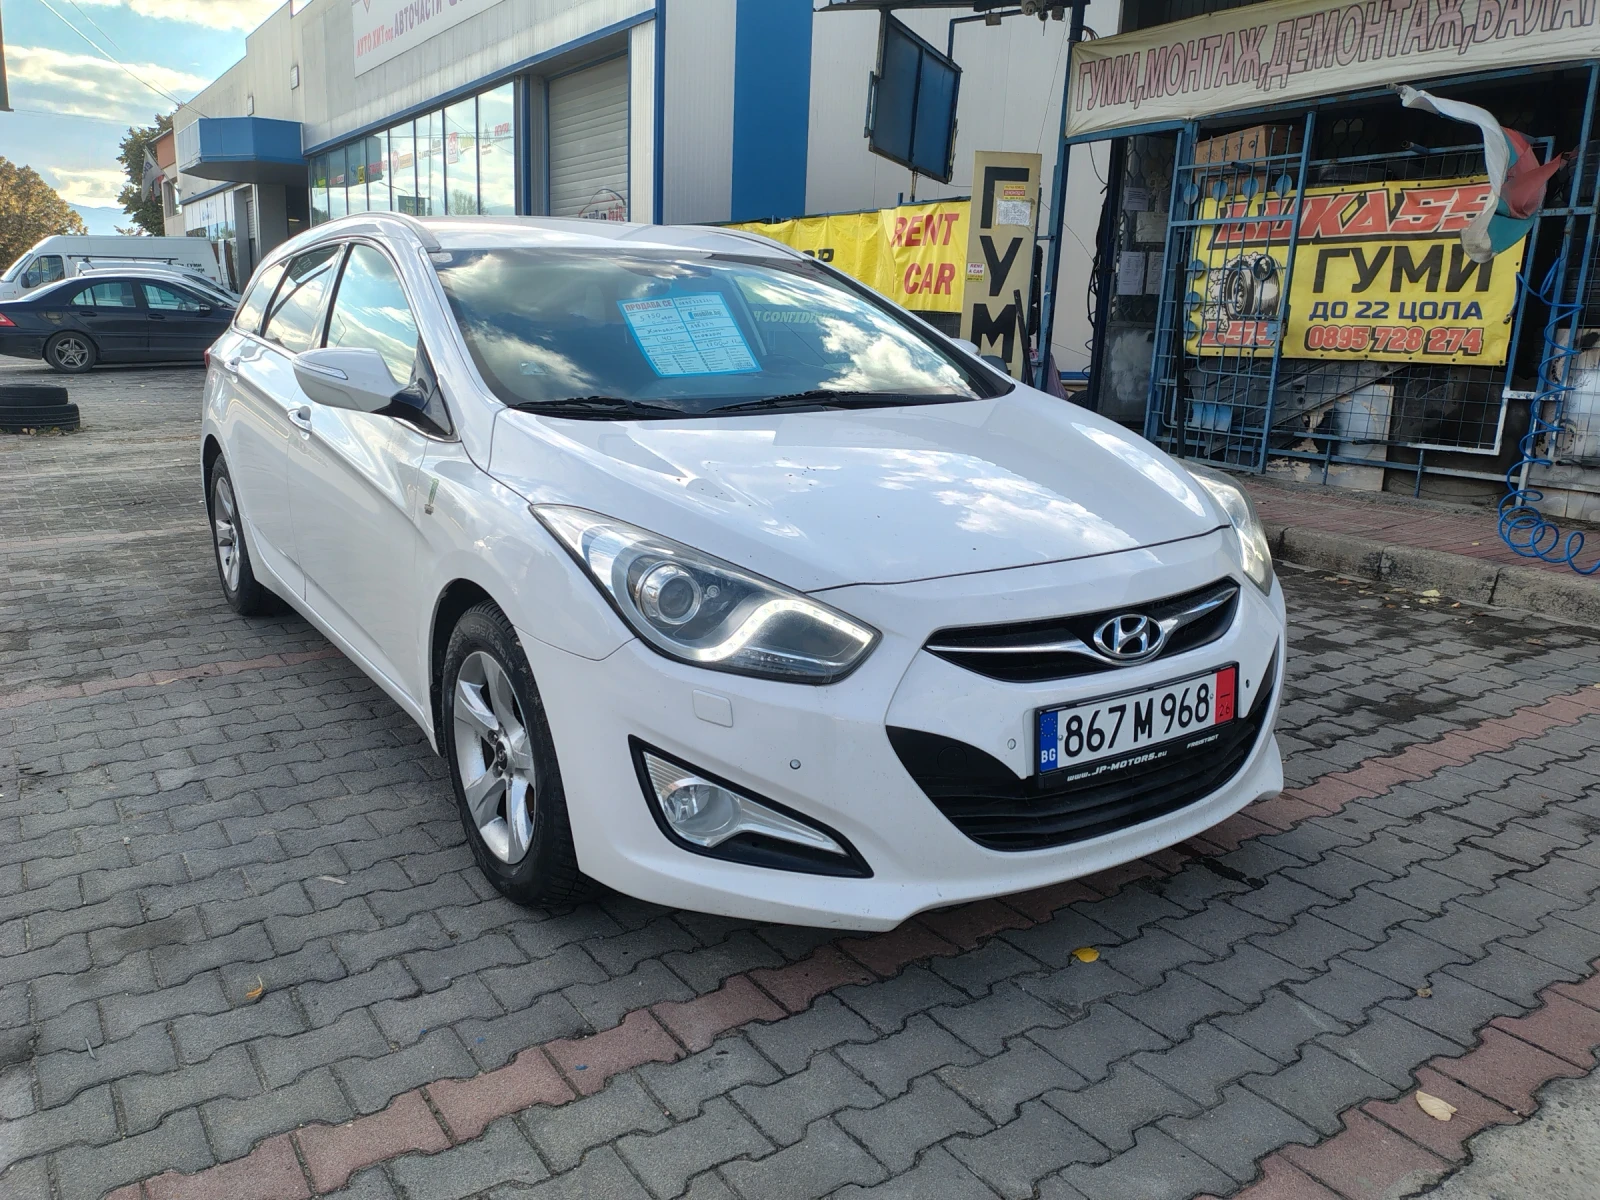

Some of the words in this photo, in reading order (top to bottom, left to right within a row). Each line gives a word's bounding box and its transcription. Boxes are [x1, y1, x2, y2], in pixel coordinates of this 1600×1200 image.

[1214, 184, 1493, 244] LUKASS
[891, 213, 959, 248] RENT
[904, 263, 956, 295] CAR
[1313, 244, 1495, 294] ГУМИ
[625, 301, 661, 311] ПРОДАВА
[1309, 302, 1349, 322] ДО
[1355, 302, 1390, 319] 22
[1399, 302, 1483, 323] ЦОЛА
[1307, 325, 1371, 352] 0895
[1372, 327, 1425, 352] 728
[1425, 327, 1484, 356] 274
[1064, 704, 1127, 758] 867
[1133, 698, 1154, 742] M
[1160, 683, 1210, 734] 968
[1219, 703, 1231, 717] 26
[1041, 748, 1056, 764] BG
[1067, 750, 1168, 782] www.JP-MOTORS.eu
